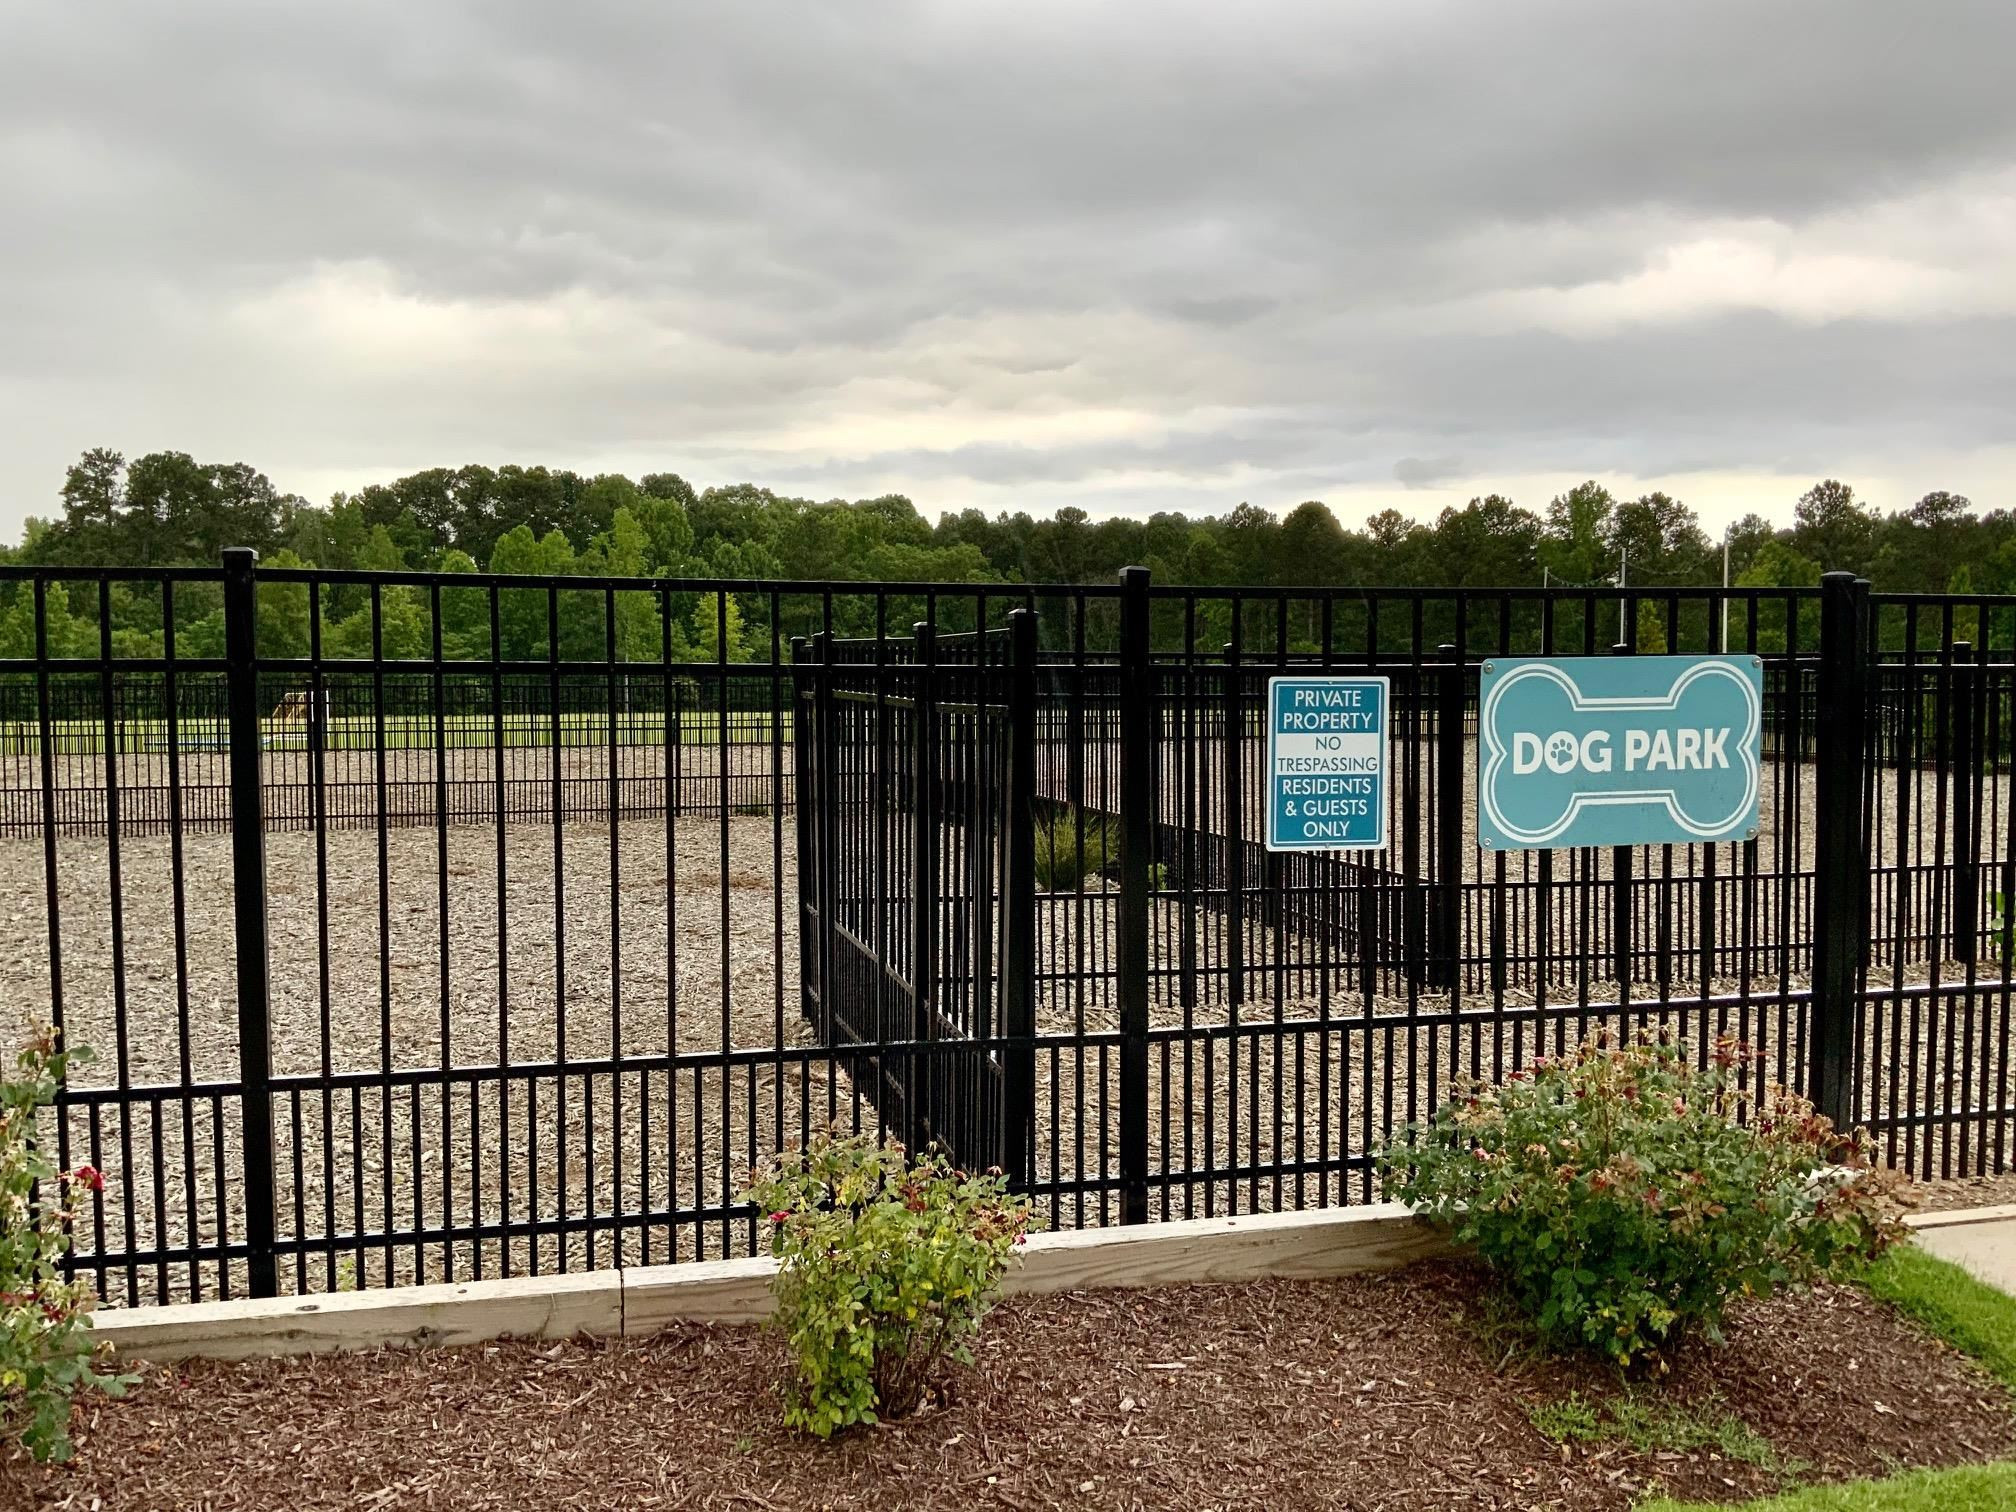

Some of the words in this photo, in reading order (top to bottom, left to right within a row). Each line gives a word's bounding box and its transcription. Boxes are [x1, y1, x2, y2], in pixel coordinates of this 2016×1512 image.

[1295, 690, 1361, 707] PRIVATE
[1283, 712, 1373, 729] PROPERTY
[1315, 736, 1341, 750] NO
[1512, 730, 1612, 775] DOG
[1625, 727, 1731, 771] PARK
[1277, 757, 1378, 771] TRESPASSING
[1282, 778, 1371, 794] RESIDENTS
[1285, 801, 1297, 816] &
[1303, 799, 1367, 816] GUESTS
[1303, 821, 1350, 837] ONLY
